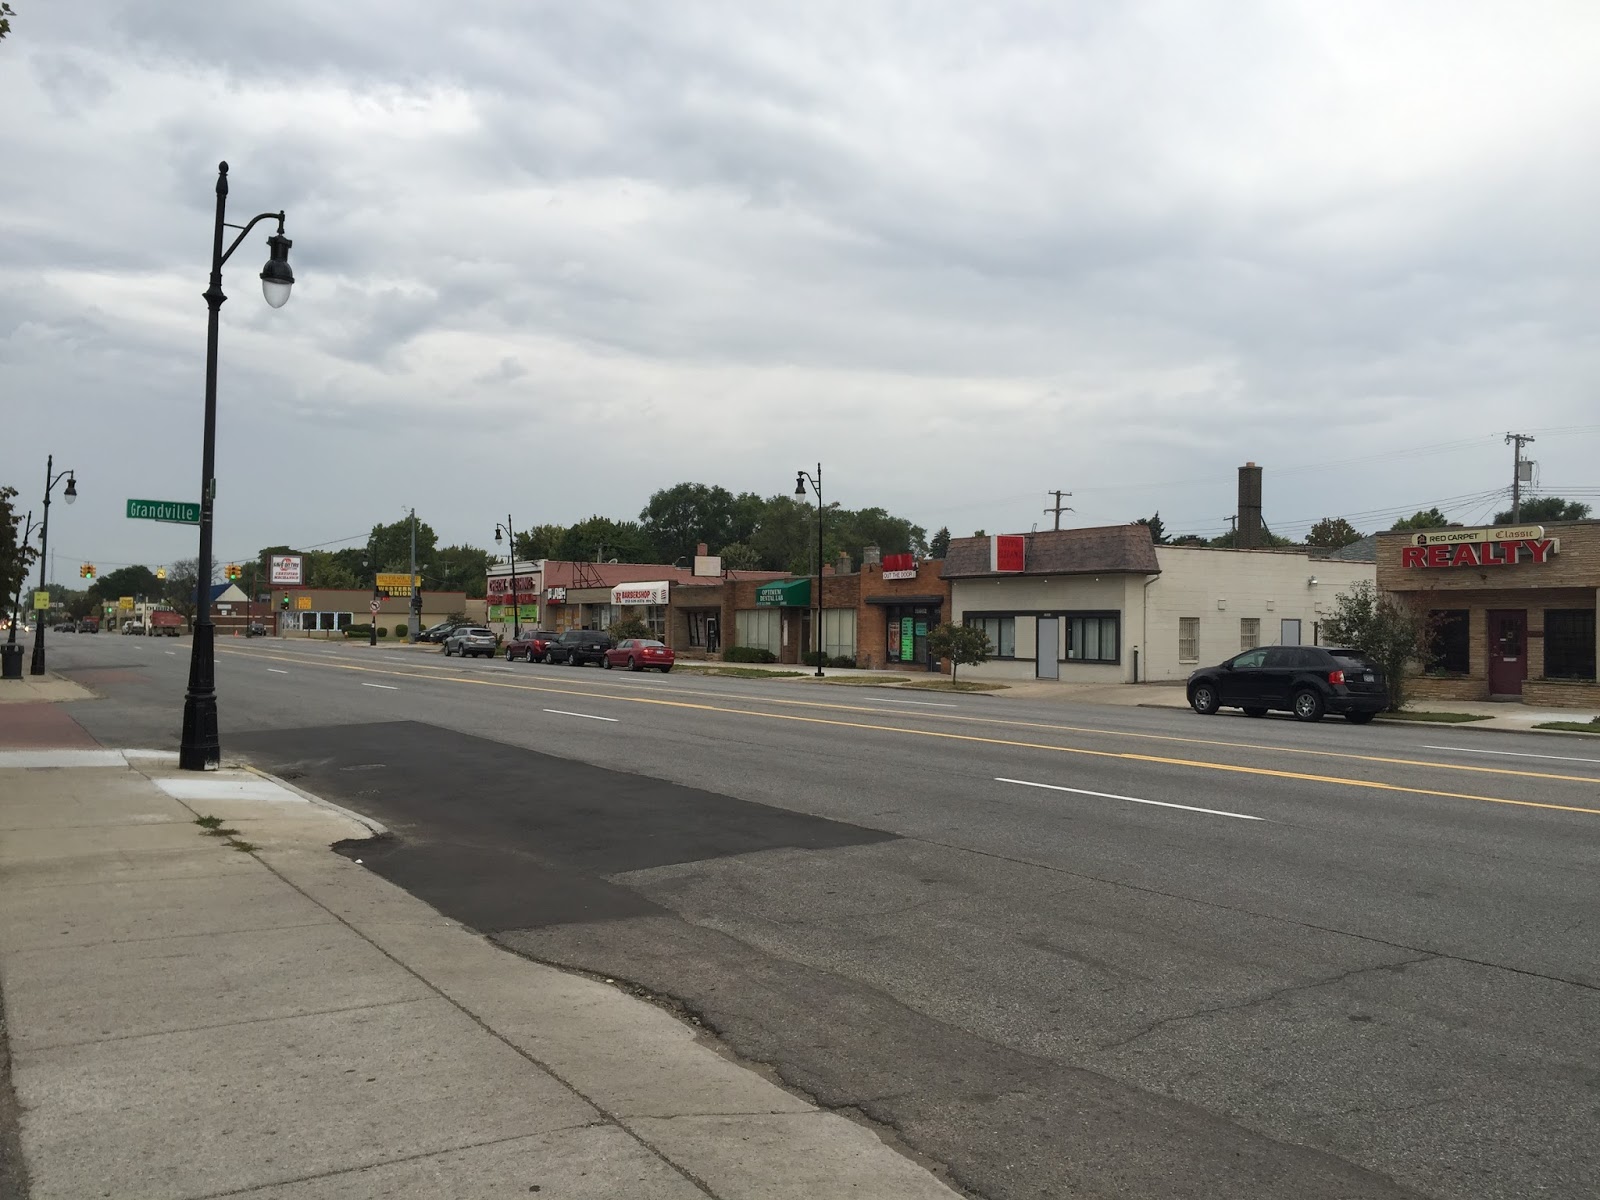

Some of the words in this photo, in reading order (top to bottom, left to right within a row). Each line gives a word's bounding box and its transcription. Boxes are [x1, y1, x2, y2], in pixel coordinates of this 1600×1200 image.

[131, 502, 193, 519] Grandville
[1429, 535, 1446, 543] RED
[1447, 532, 1480, 541] CARPET
[1495, 529, 1534, 539] Classic
[1402, 539, 1552, 568] REALTY
[509, 577, 533, 590] CSHING
[622, 590, 650, 599] BARBERSHOP
